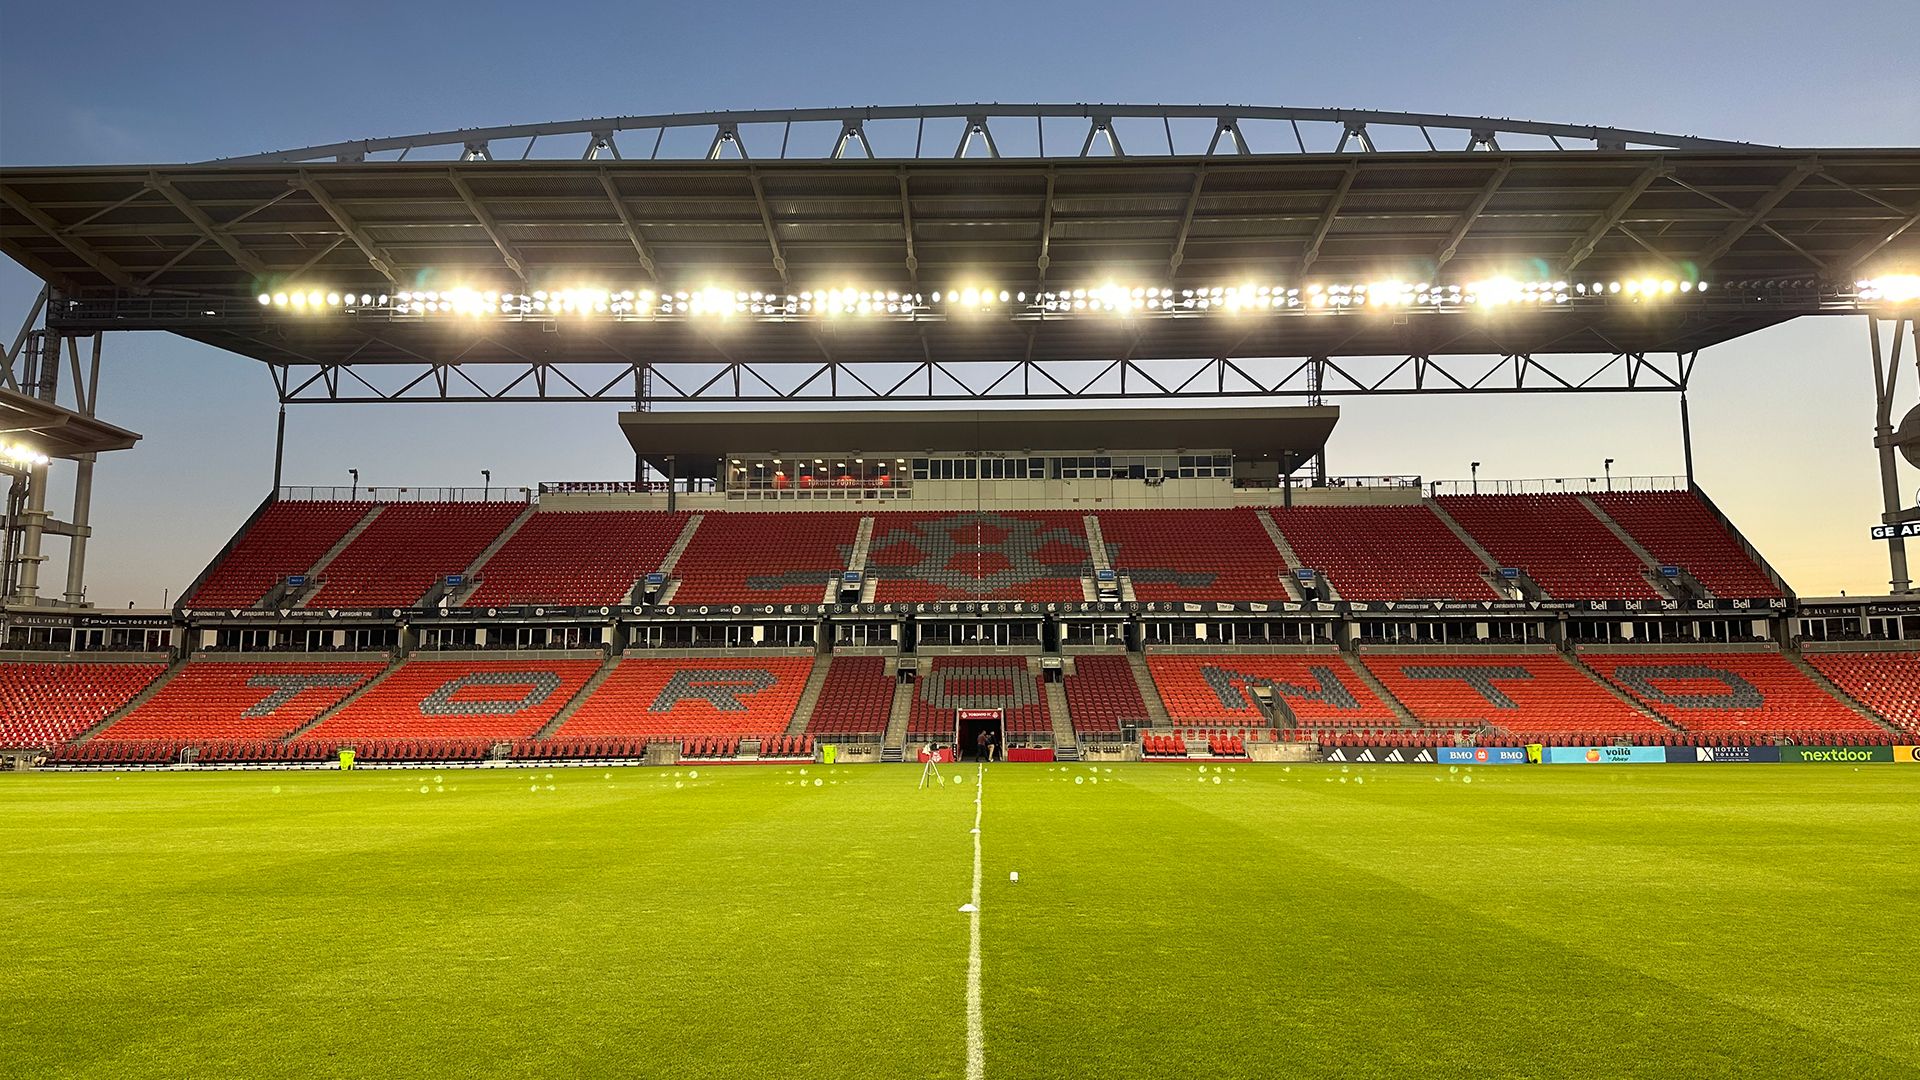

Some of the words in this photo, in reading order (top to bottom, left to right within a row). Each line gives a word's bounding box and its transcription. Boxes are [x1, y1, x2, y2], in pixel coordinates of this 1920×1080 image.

[1872, 526, 1895, 538] GE
[1590, 600, 1607, 610] Bell
[1625, 600, 1642, 610] Bell
[1660, 600, 1678, 610] Bell
[1696, 600, 1714, 608] Bell
[1733, 599, 1750, 608] Bell
[1770, 598, 1786, 608] Bell
[1801, 748, 1872, 760] nextdoor
